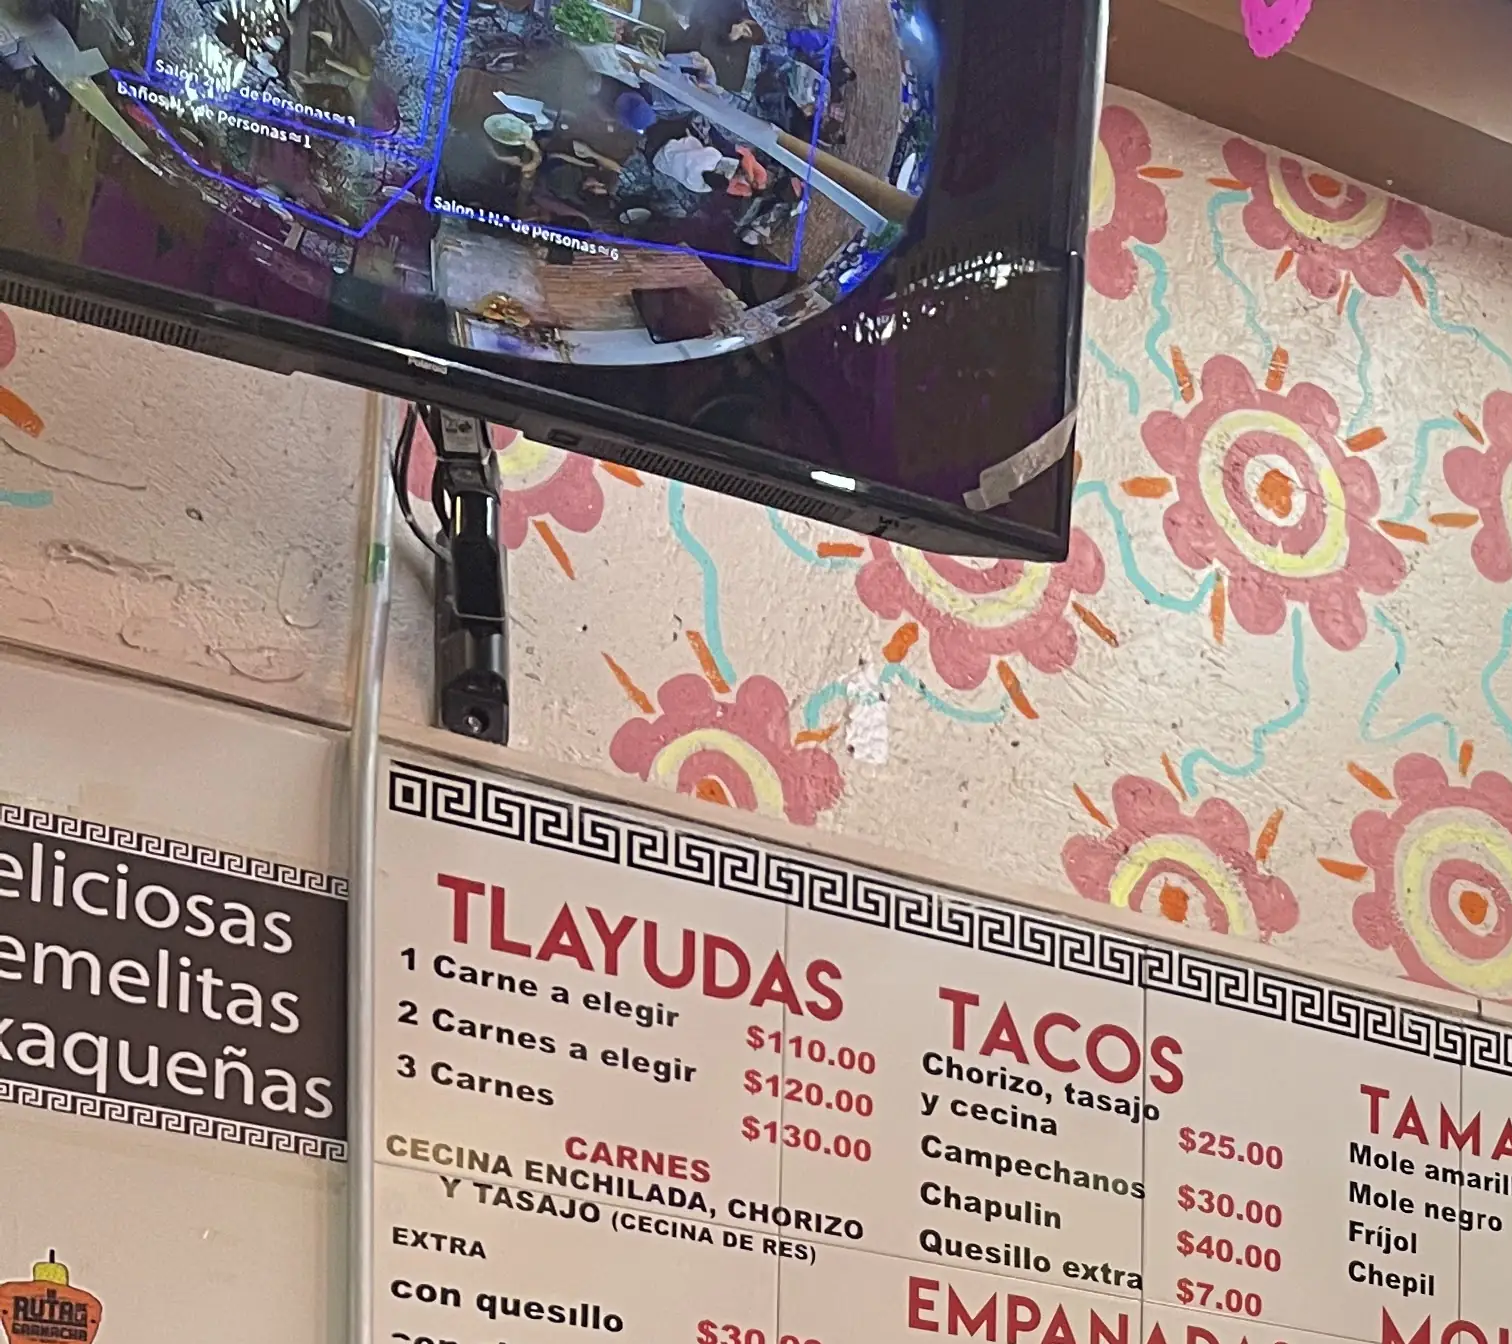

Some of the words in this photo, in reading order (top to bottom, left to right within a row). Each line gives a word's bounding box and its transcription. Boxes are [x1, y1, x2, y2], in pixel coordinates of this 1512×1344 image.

[437, 873, 843, 1021] TLAYUDAS
[401, 948, 416, 970] 1
[433, 955, 537, 997] Carne
[552, 986, 569, 1005] a
[583, 991, 679, 1028] elegir
[746, 1025, 876, 1075] $110.00
[939, 986, 1184, 1094] TACOS
[398, 1001, 418, 1025] 2
[432, 1009, 555, 1054] Carnes
[569, 1041, 587, 1061] a
[601, 1048, 697, 1084] elegir
[744, 1069, 874, 1117] $120.00
[922, 1051, 1053, 1105] Chorizo,
[1064, 1082, 1160, 1124] tasajo
[397, 1055, 416, 1077] 3
[431, 1061, 554, 1106] Carnes
[741, 1115, 872, 1162] $130.00
[921, 1092, 939, 1116] y
[950, 1097, 1058, 1136] cecina
[1178, 1126, 1283, 1170] $25.00
[386, 1134, 513, 1178] CECINA
[525, 1160, 716, 1217] ENCHILADA,
[728, 1198, 864, 1240] CHORIZO
[565, 1136, 711, 1183] CARNES
[921, 1134, 1146, 1200] Campechanos
[1177, 1184, 1283, 1228] $30.00
[1349, 1141, 1415, 1176] Mole
[392, 1227, 486, 1260] EXTRA
[439, 1175, 461, 1198] Y
[473, 1181, 601, 1223] TASAJO
[611, 1211, 714, 1245] (CECINA
[723, 1230, 753, 1251] DE
[763, 1238, 817, 1266] RES)
[920, 1181, 1062, 1230] Chapulin
[1176, 1230, 1282, 1272] $40.00
[1349, 1180, 1415, 1214] Mole
[1425, 1201, 1503, 1232] negro
[391, 1279, 461, 1307] con
[476, 1288, 624, 1333] quesillo
[919, 1229, 1051, 1273] Quesillo
[1062, 1261, 1143, 1291] extra
[1176, 1277, 1262, 1317] $7.00
[1348, 1260, 1435, 1297] Chepil
